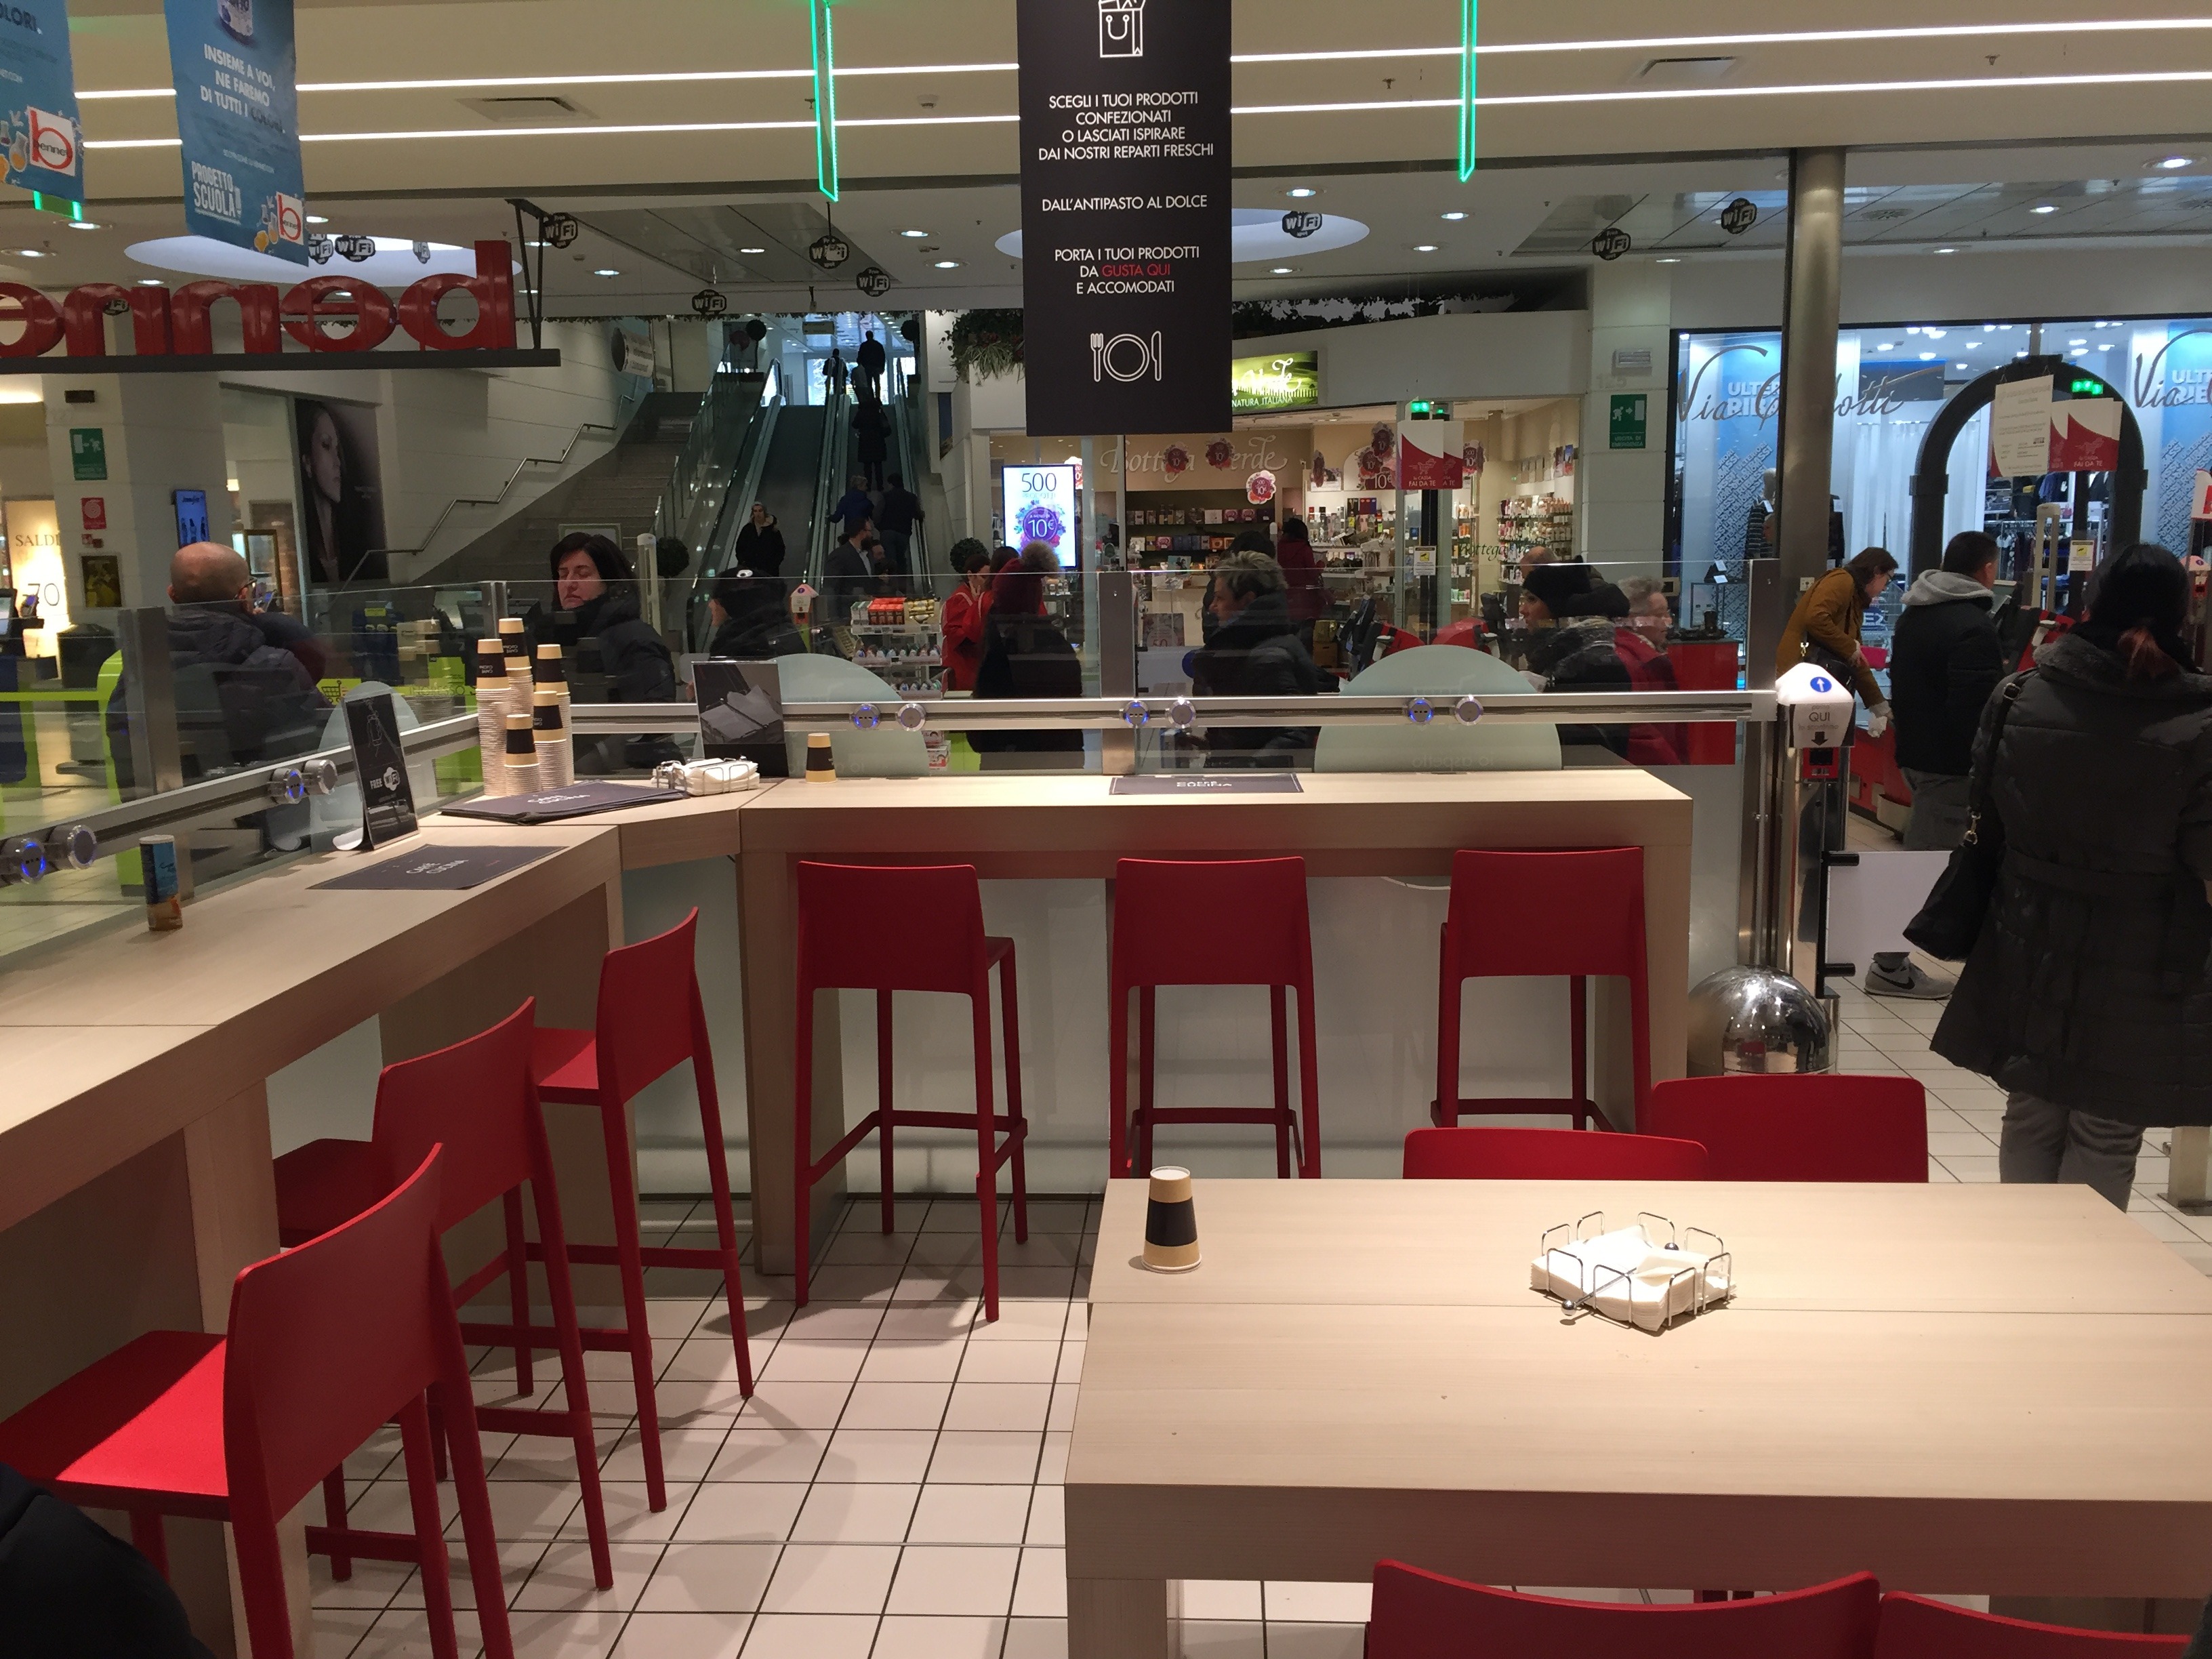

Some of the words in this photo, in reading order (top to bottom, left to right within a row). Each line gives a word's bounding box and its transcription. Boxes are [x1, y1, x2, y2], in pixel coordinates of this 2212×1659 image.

[0, 2, 43, 35] LORI.
[204, 43, 245, 75] INSIEME
[247, 64, 254, 80] A
[215, 70, 231, 89] NE
[233, 77, 270, 107] FAREMO
[200, 85, 212, 103] DI
[214, 91, 242, 115] TUTTI
[244, 103, 249, 117] I
[1049, 95, 1091, 109] SCEGLI
[1095, 94, 1099, 107] I
[1102, 94, 1132, 107] TUOI
[1136, 91, 1198, 106] PRODOTTI
[1076, 110, 1171, 125] CONFEZIONATI
[1062, 130, 1074, 143] O
[1078, 128, 1130, 142] LASCIATI
[1134, 127, 1185, 141] ISPIRARE
[1038, 148, 1060, 161] DAI
[1064, 146, 1109, 160] NOSTRI
[1114, 144, 1160, 159] REPARTI
[1164, 143, 1214, 157] FRESCHI
[191, 161, 234, 192] PROGETTO
[1042, 196, 1143, 211] DALL'ANTIPASTO
[1147, 196, 1163, 209] AL
[1166, 194, 1208, 209] DOLCE
[1055, 249, 1094, 262] PORTA
[1098, 249, 1101, 260] I
[1105, 247, 1134, 261] TUOI
[1139, 246, 1200, 260] PRODOTTI
[1080, 266, 1099, 278] DA
[1102, 264, 1144, 278] GUSTA
[1147, 263, 1170, 276] QUI
[859, 275, 888, 288] WiFi
[1076, 283, 1084, 294] E
[1087, 281, 1174, 294] ACCOMODATI
[695, 297, 724, 309] WiFi
[2134, 328, 2212, 408] Via
[2172, 369, 2212, 385] ULT
[1231, 398, 1259, 407] NATURA
[1262, 396, 1293, 405] ITALIANA
[1100, 441, 1195, 483] Botta
[1021, 473, 1057, 492] 500
[1027, 518, 1055, 537] 10€
[1809, 712, 1830, 722] QUI
[369, 777, 383, 790] FREE
